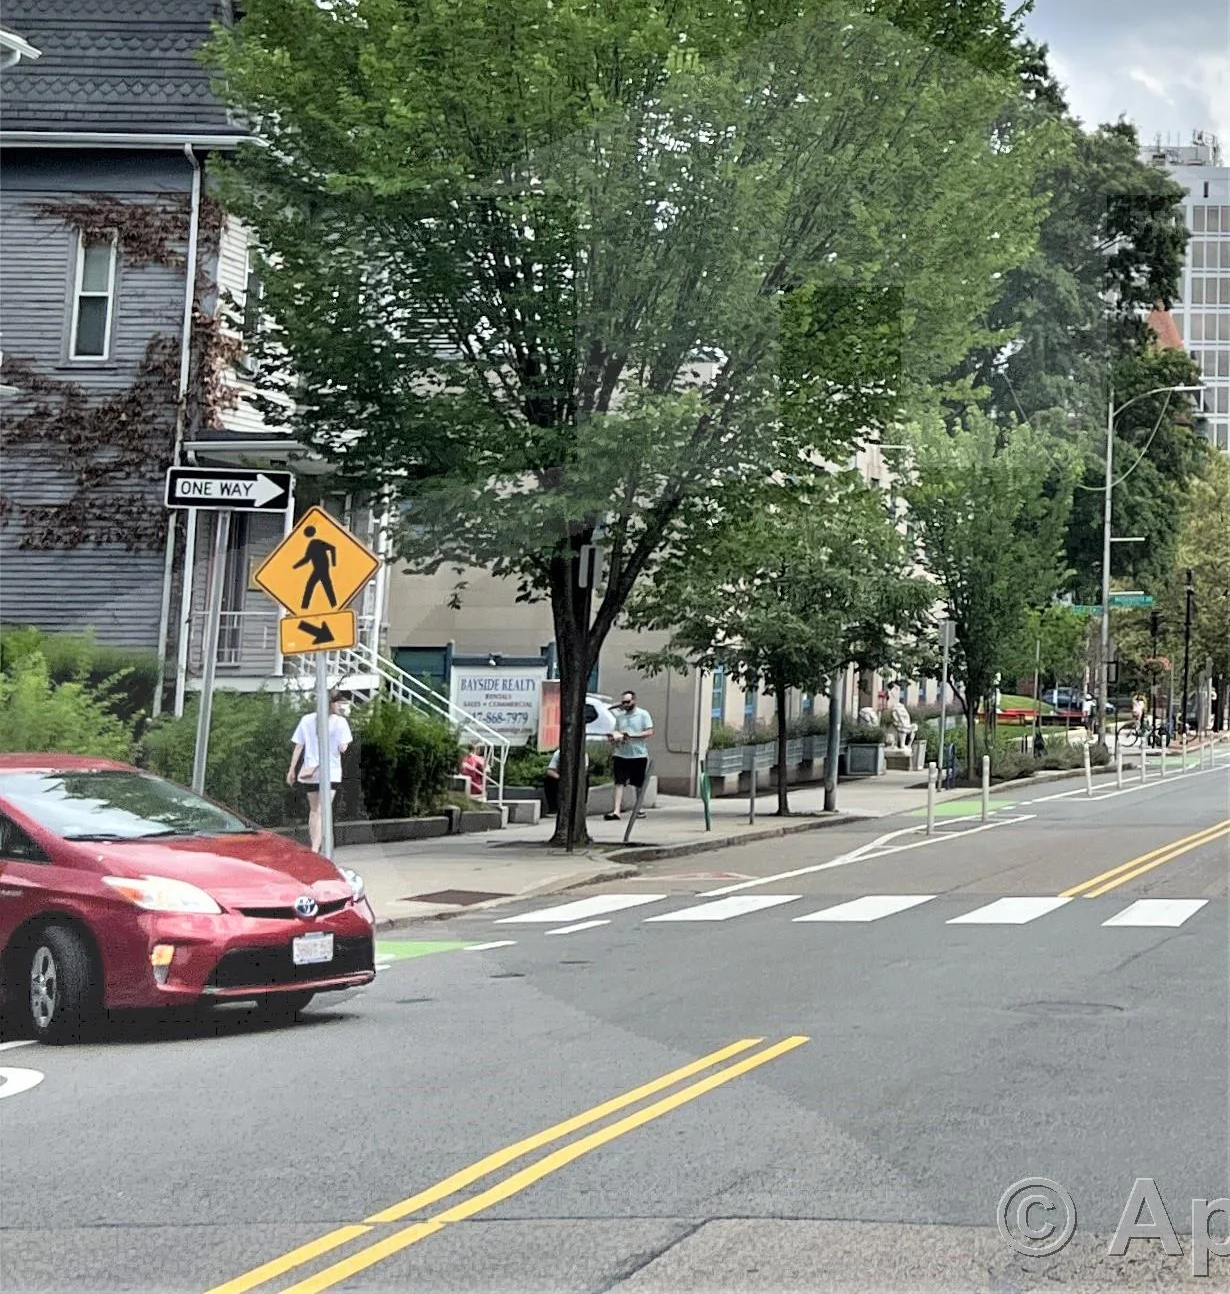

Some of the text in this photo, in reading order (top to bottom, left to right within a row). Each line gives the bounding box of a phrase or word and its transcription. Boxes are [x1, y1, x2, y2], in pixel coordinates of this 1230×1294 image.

[181, 480, 254, 497] ONE WAY
[461, 678, 536, 691] BAYSIDE REALTY
